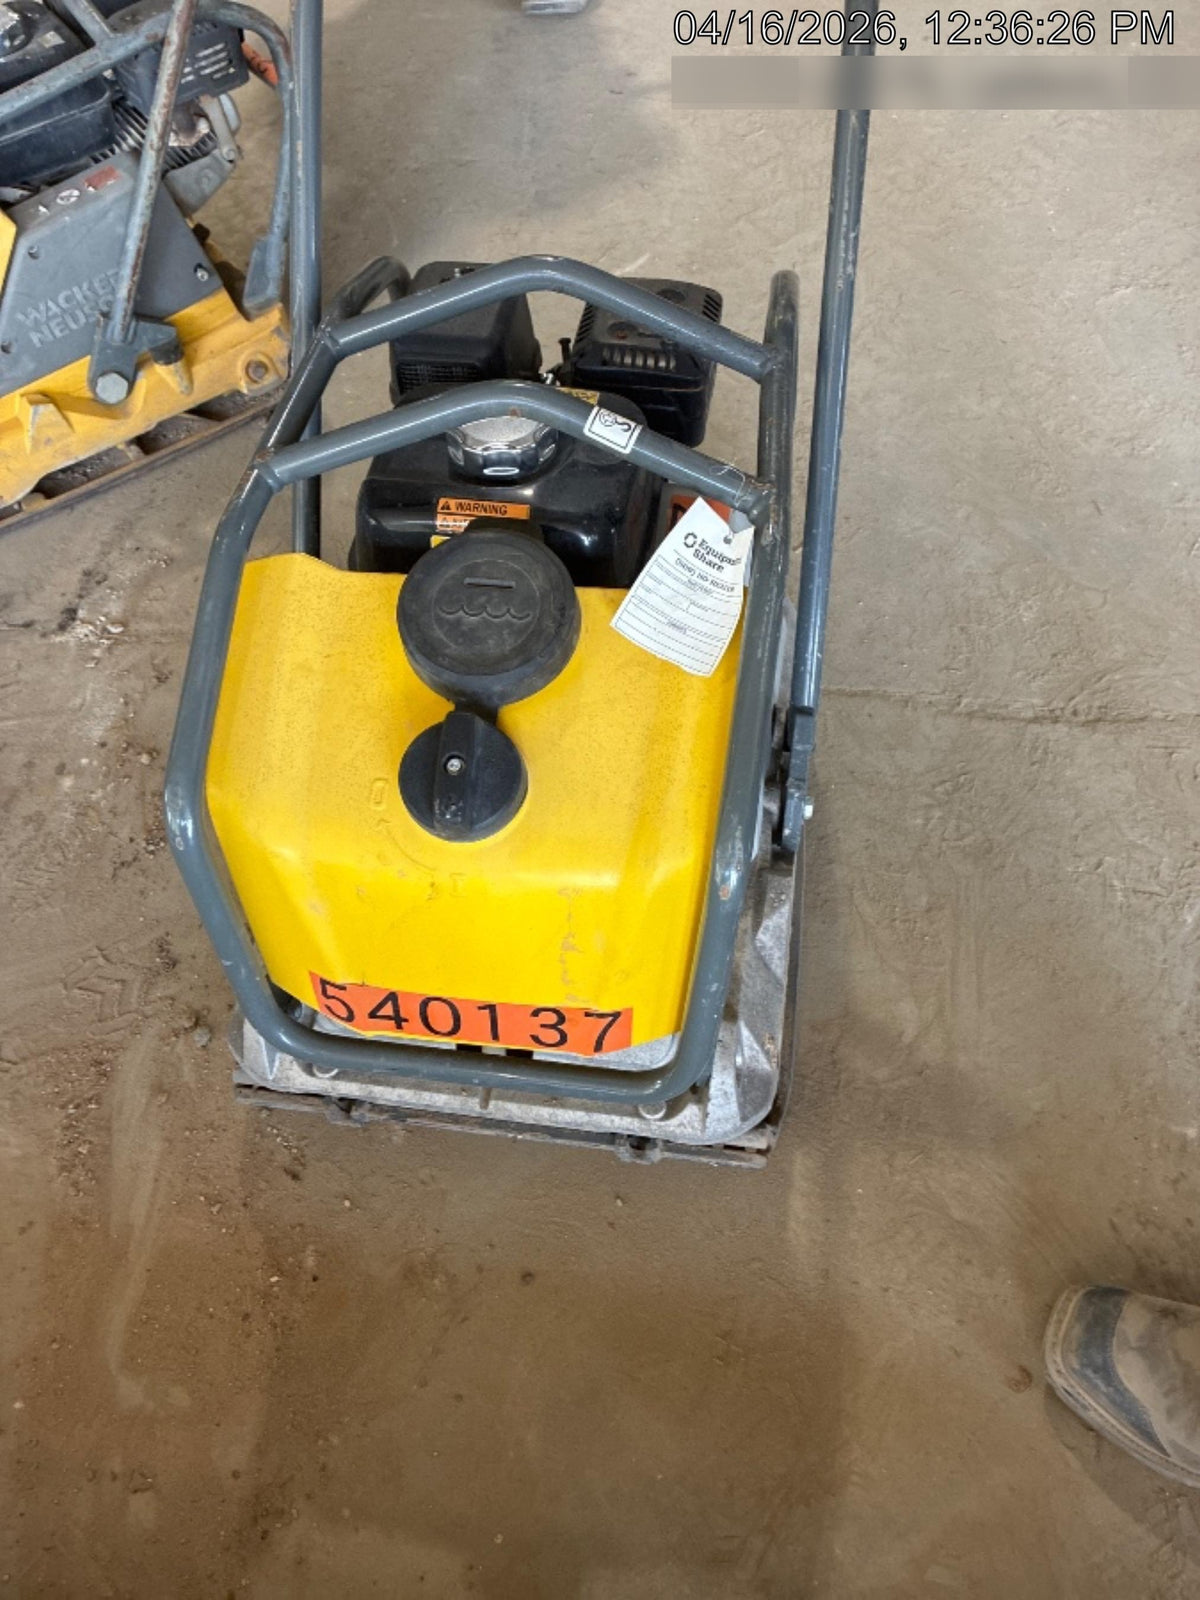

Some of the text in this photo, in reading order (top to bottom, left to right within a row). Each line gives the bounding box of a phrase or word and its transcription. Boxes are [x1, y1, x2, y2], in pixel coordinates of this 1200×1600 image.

[455, 501, 508, 516] WARNING
[693, 548, 724, 573] Share
[319, 977, 622, 1053] 540137
